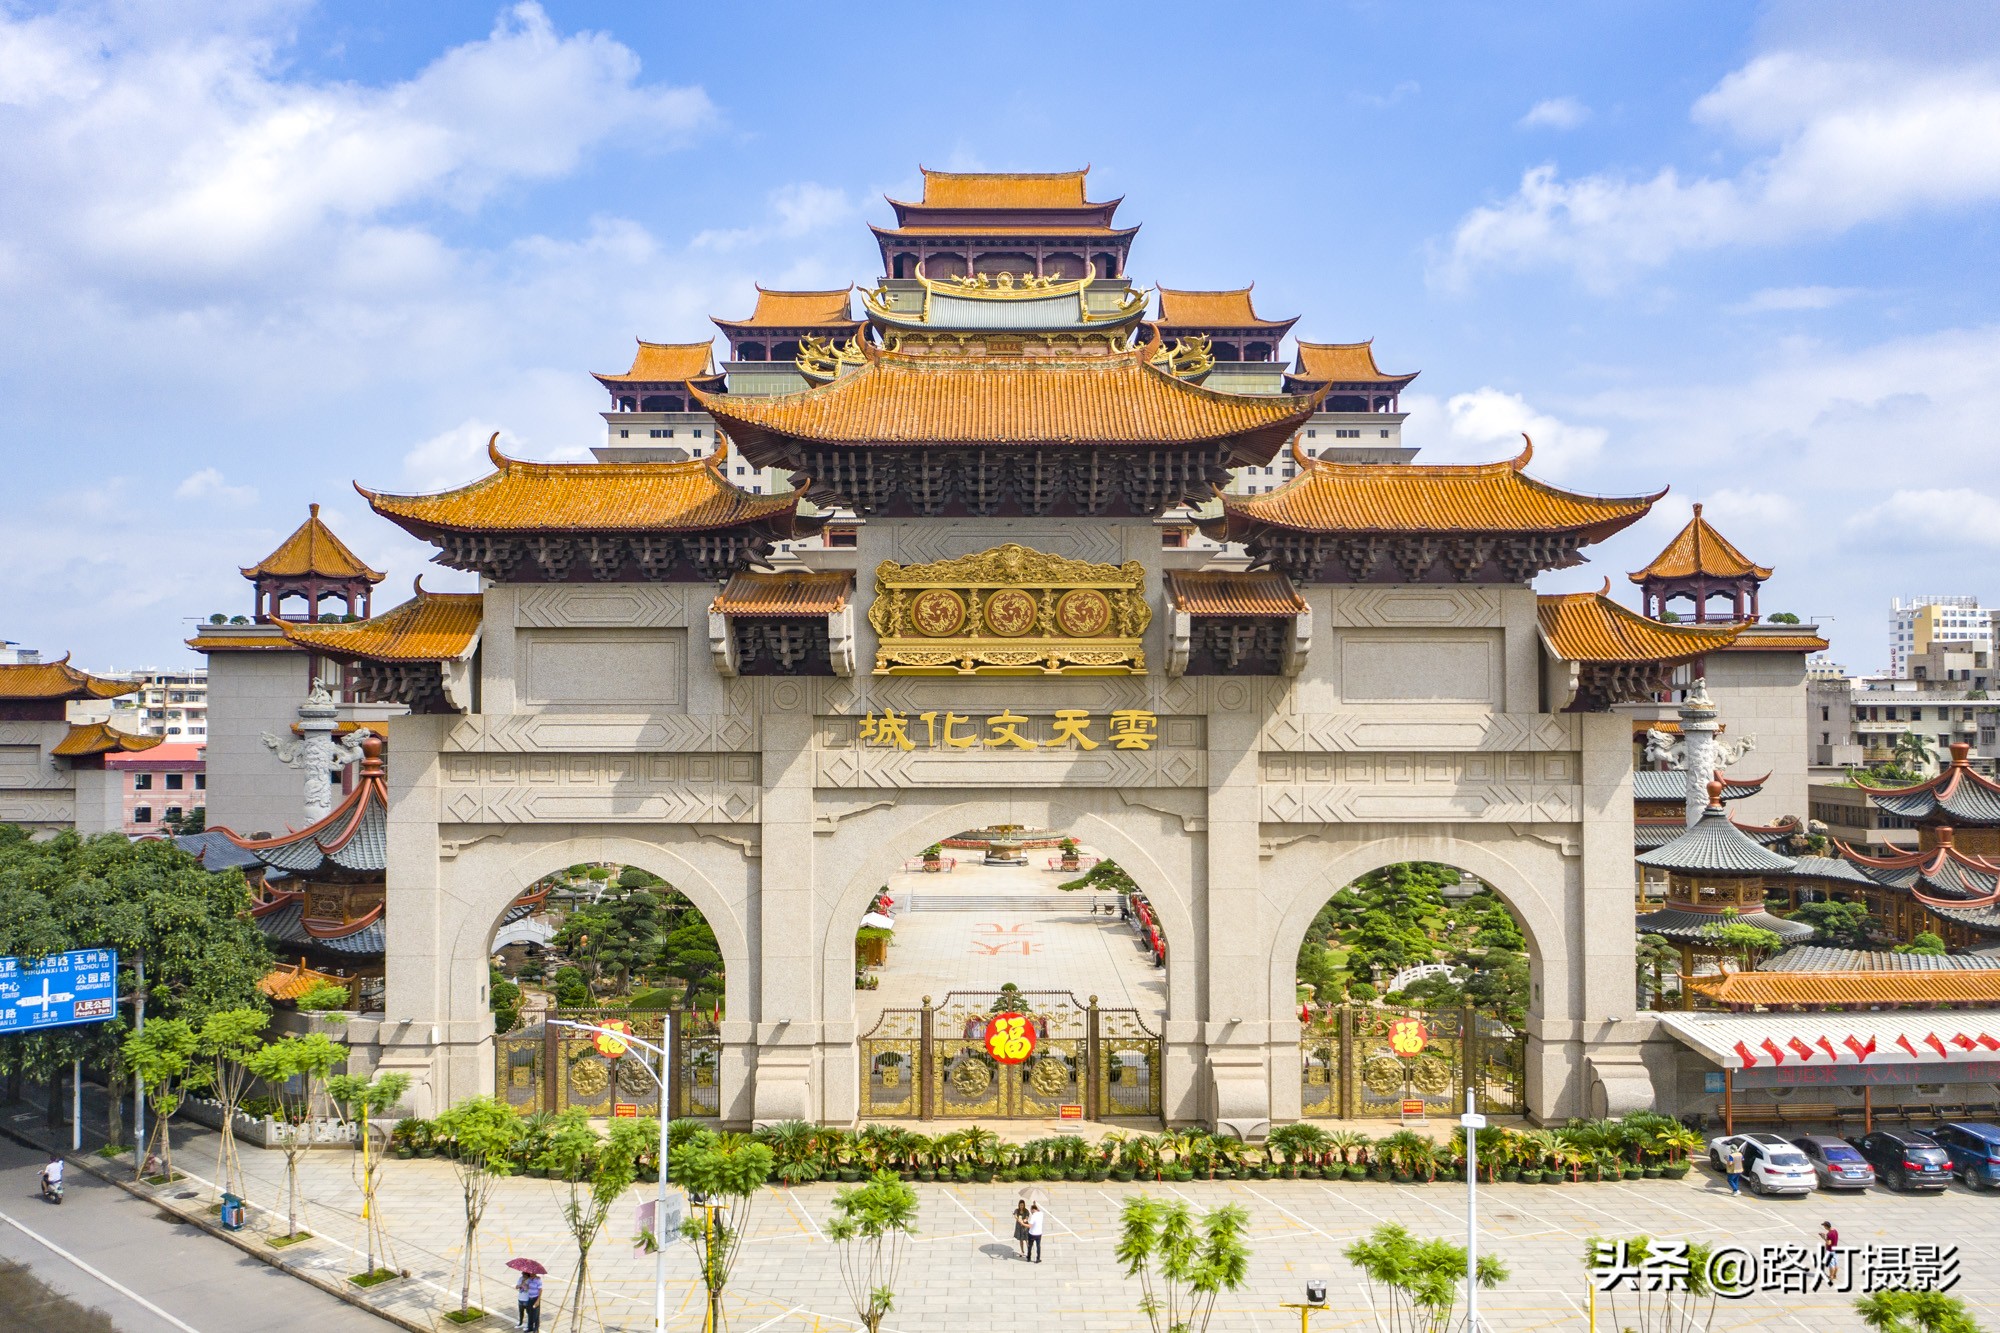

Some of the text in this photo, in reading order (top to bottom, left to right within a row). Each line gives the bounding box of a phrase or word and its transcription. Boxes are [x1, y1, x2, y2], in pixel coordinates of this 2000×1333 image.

[74, 952, 109, 964] 玉州路
[76, 972, 110, 984] 公园路
[76, 1000, 111, 1011] 人民公园
[990, 1016, 1031, 1059] 福
[1392, 1021, 1424, 1053] 福
